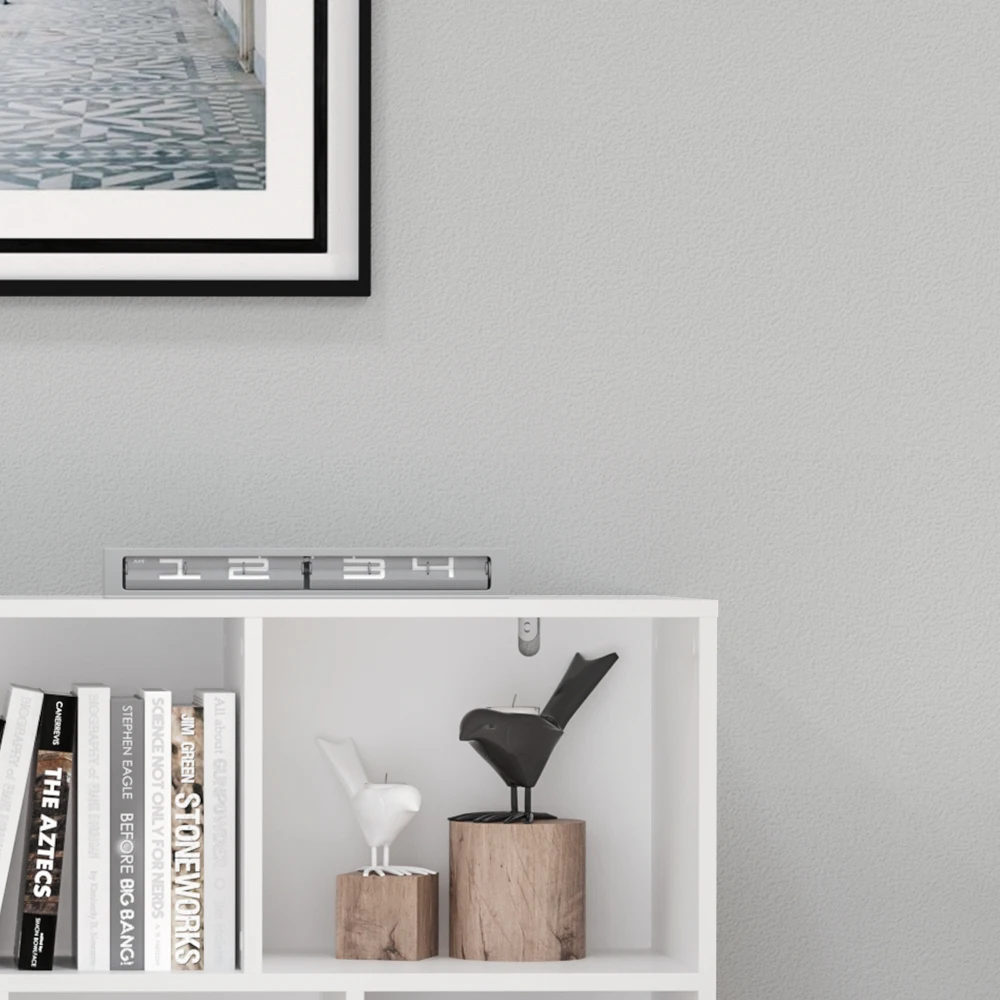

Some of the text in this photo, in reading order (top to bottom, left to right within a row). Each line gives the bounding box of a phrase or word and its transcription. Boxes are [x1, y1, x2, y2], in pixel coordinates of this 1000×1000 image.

[52, 700, 63, 745] CANERREVIS
[150, 697, 164, 752] SCIENCE
[213, 696, 224, 716] All
[122, 704, 133, 800] STEPHEN EAGLE
[180, 714, 195, 784] JIM GREEN
[214, 719, 225, 754] about
[150, 756, 164, 790] NOT
[33, 767, 62, 897] THE AZTECS
[150, 798, 164, 836] ONLY
[150, 839, 164, 869] FOR
[120, 812, 135, 966] BEFORE BIG BANG!
[150, 872, 164, 919] NERDS
[174, 792, 201, 966] STONEWORKS
